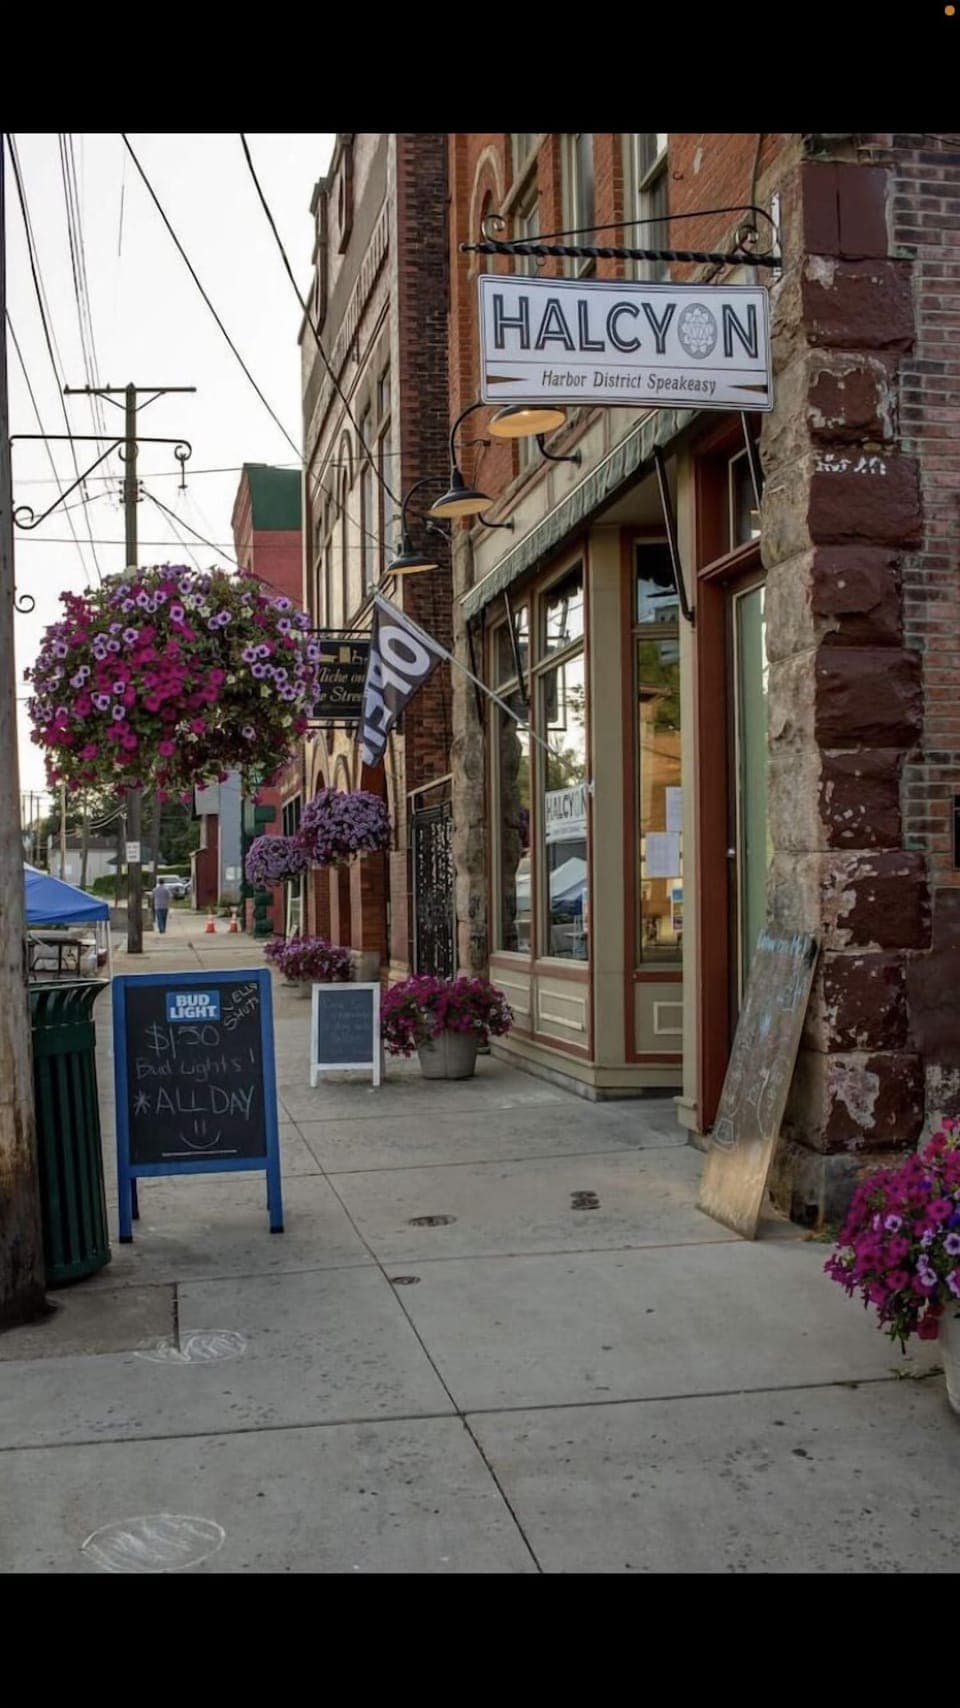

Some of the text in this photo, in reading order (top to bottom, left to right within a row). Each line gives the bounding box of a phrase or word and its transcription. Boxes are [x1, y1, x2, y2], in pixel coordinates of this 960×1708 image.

[493, 294, 759, 359] HALCYON
[542, 370, 717, 394] Harbor District Speakeasy
[169, 1005, 218, 1019] LIGHT
[176, 994, 210, 1007] BUD
[135, 1056, 172, 1080] Bud
[208, 1084, 255, 1121] DAY
